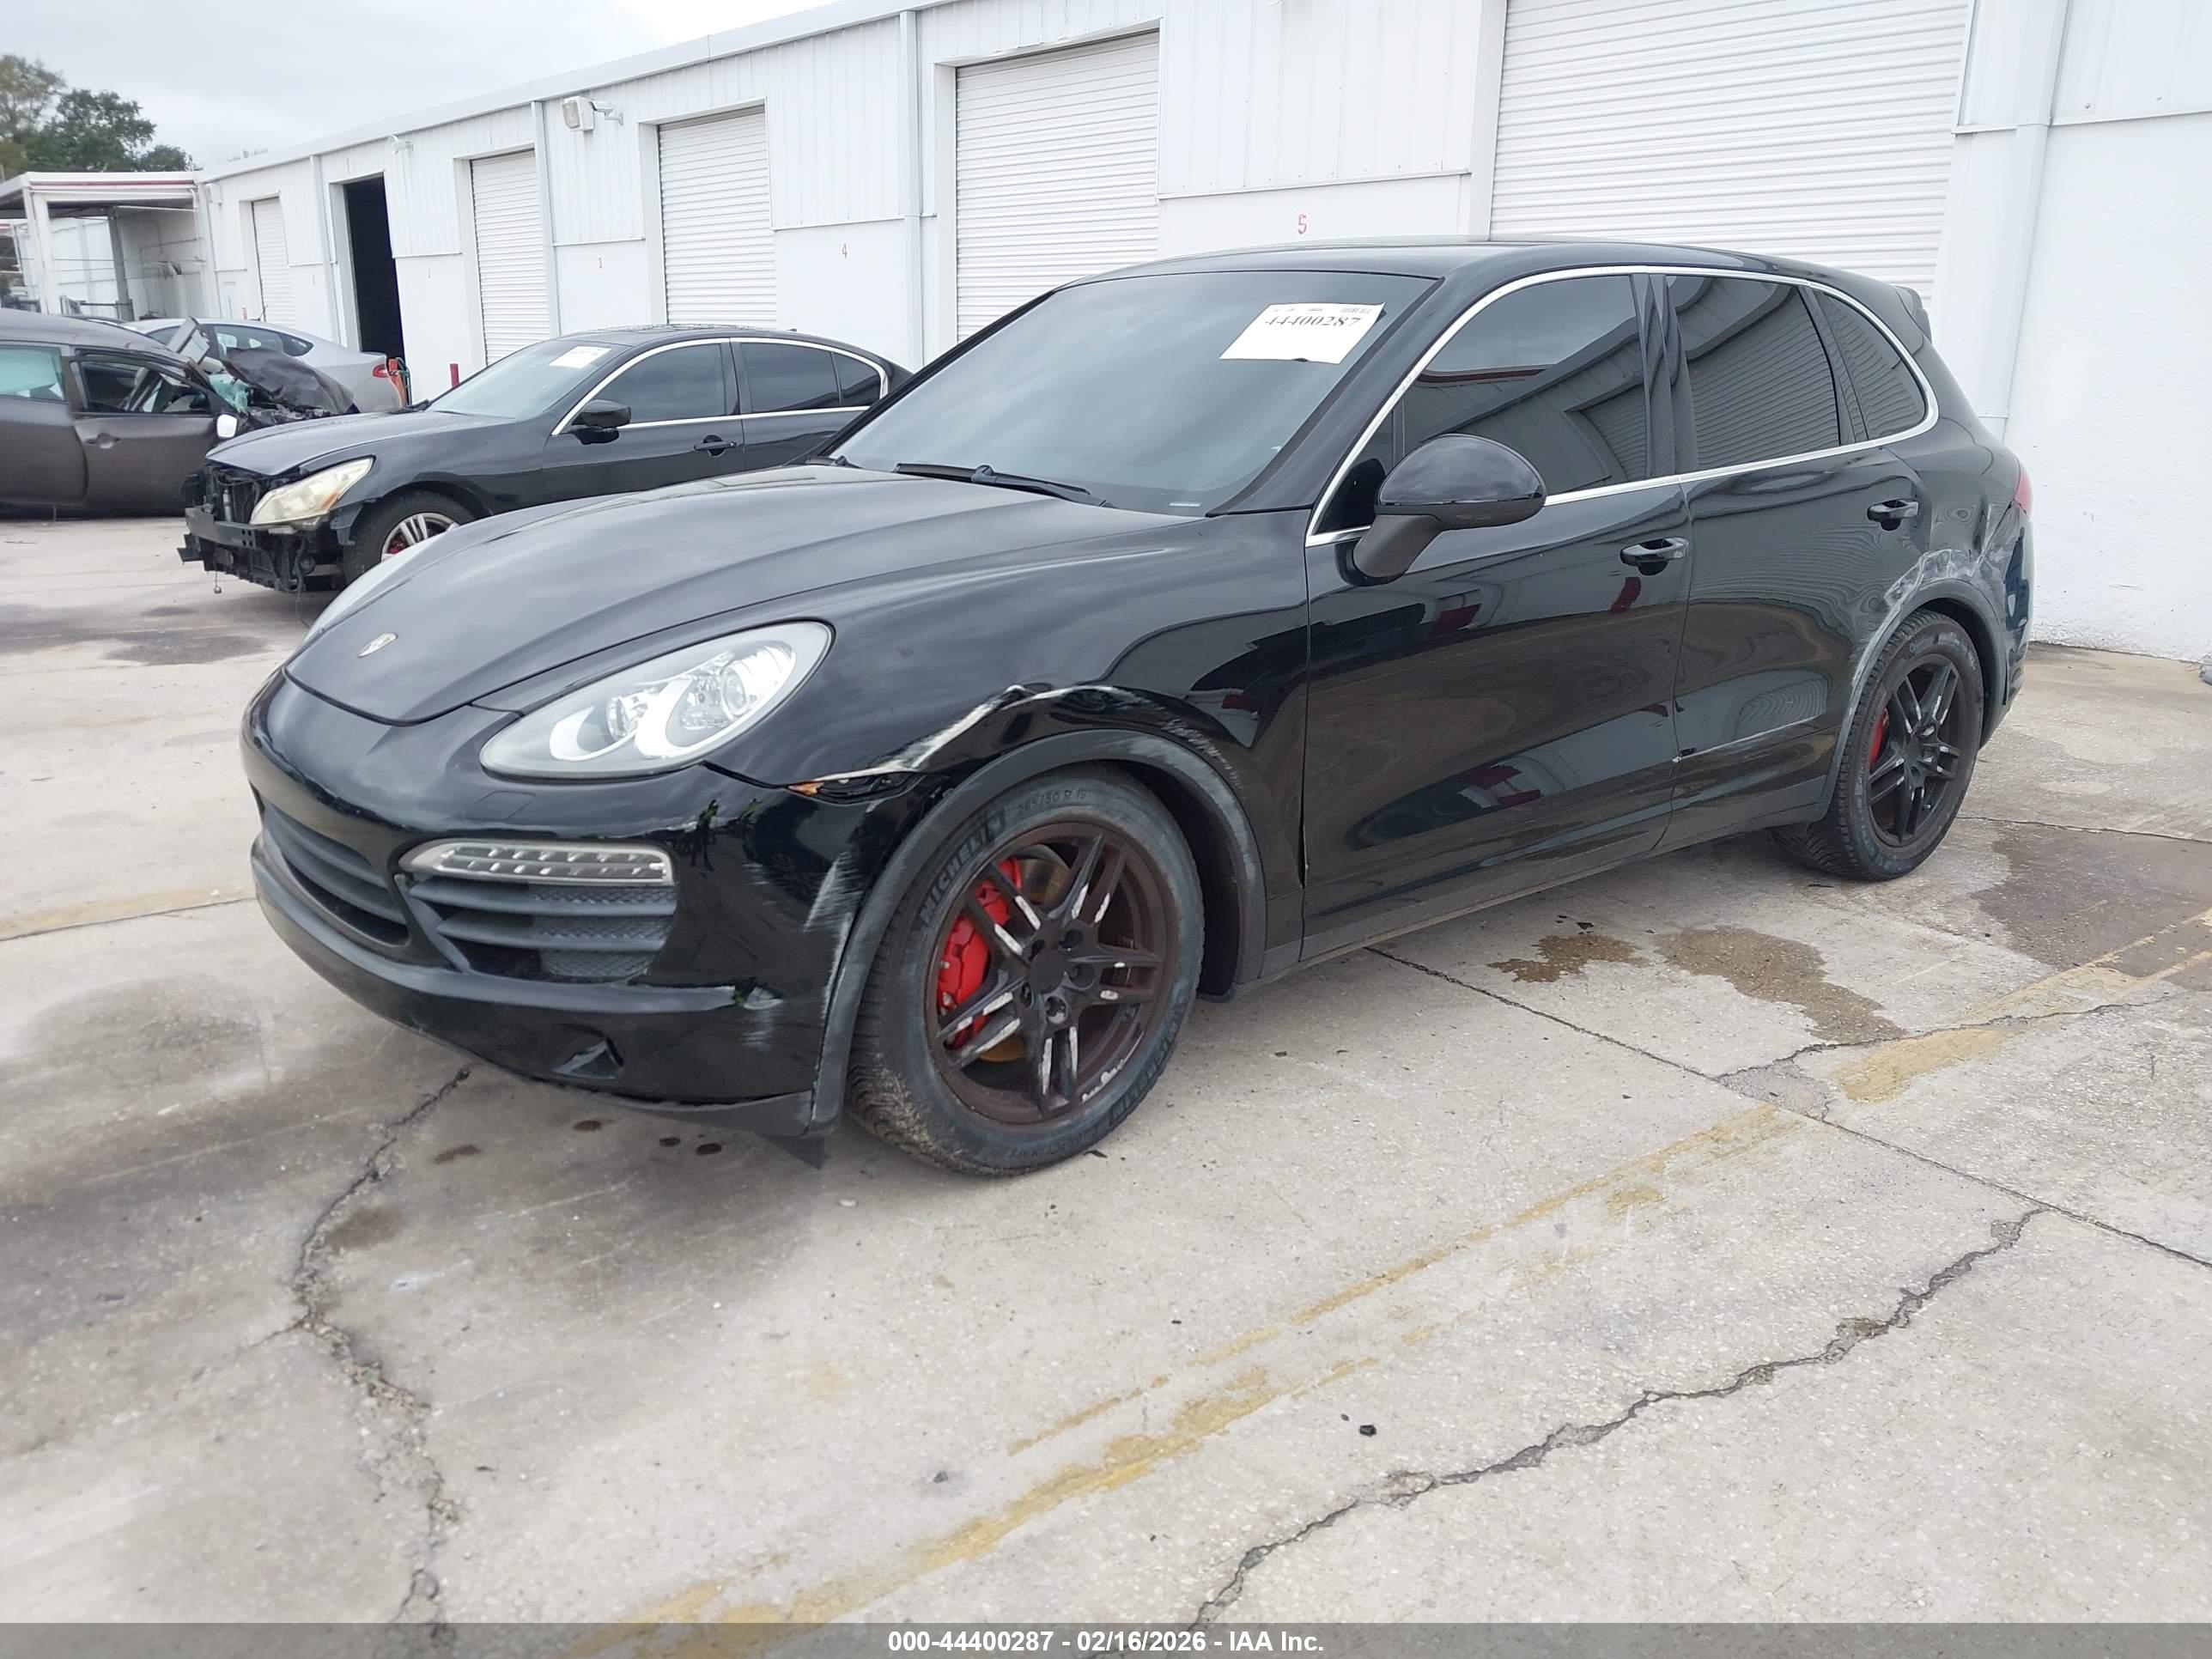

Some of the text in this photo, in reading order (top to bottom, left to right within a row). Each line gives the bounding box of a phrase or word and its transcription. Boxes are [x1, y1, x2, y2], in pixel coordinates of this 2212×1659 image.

[1297, 213, 1307, 234] 5
[842, 242, 848, 259] 4
[1265, 316, 1362, 326] 44400287
[919, 806, 1006, 927] MICHELIN
